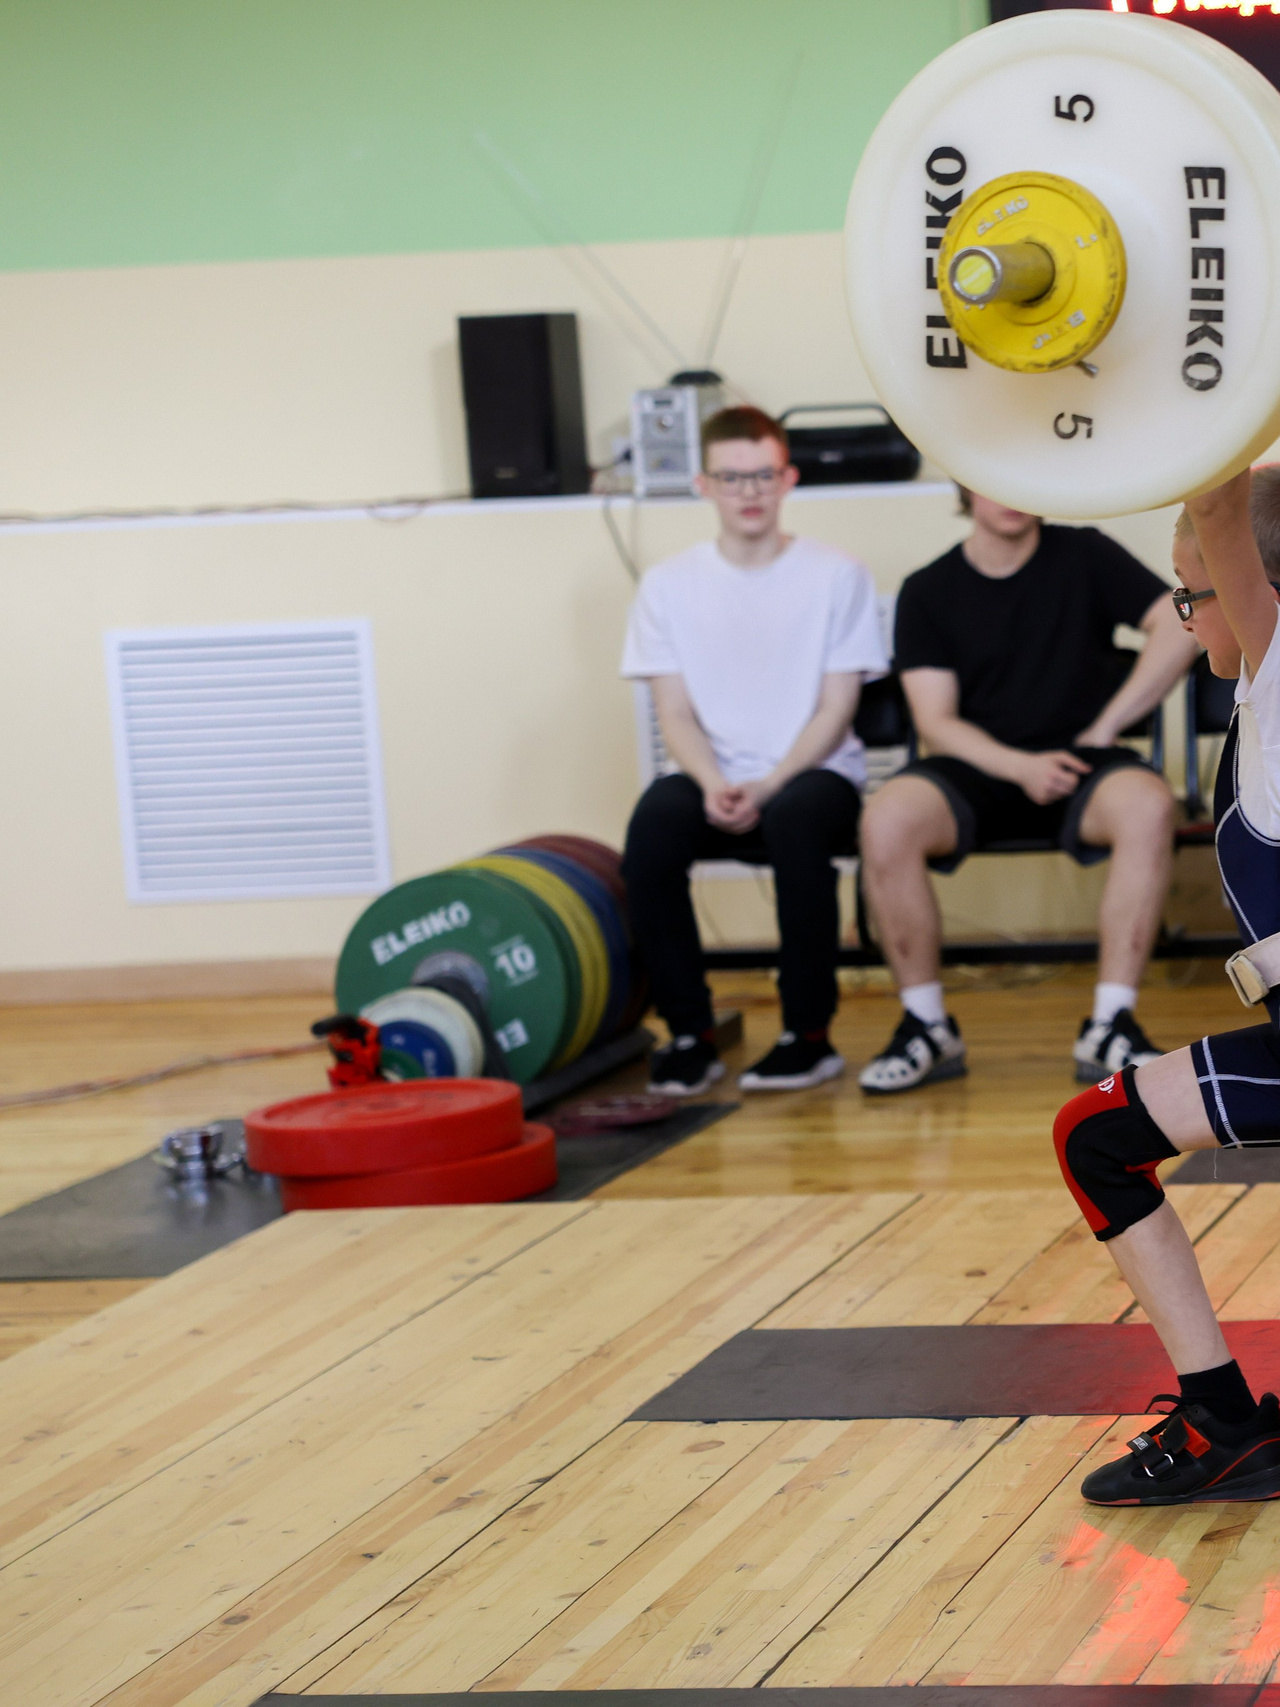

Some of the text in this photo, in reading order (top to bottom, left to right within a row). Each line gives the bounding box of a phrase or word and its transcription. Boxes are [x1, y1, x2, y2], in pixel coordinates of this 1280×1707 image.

[1055, 94, 1095, 123] 5
[1181, 166, 1226, 392] ELEIKO
[1053, 411, 1093, 440] 5
[370, 900, 472, 967] ELEIKO
[494, 942, 537, 981] 10
